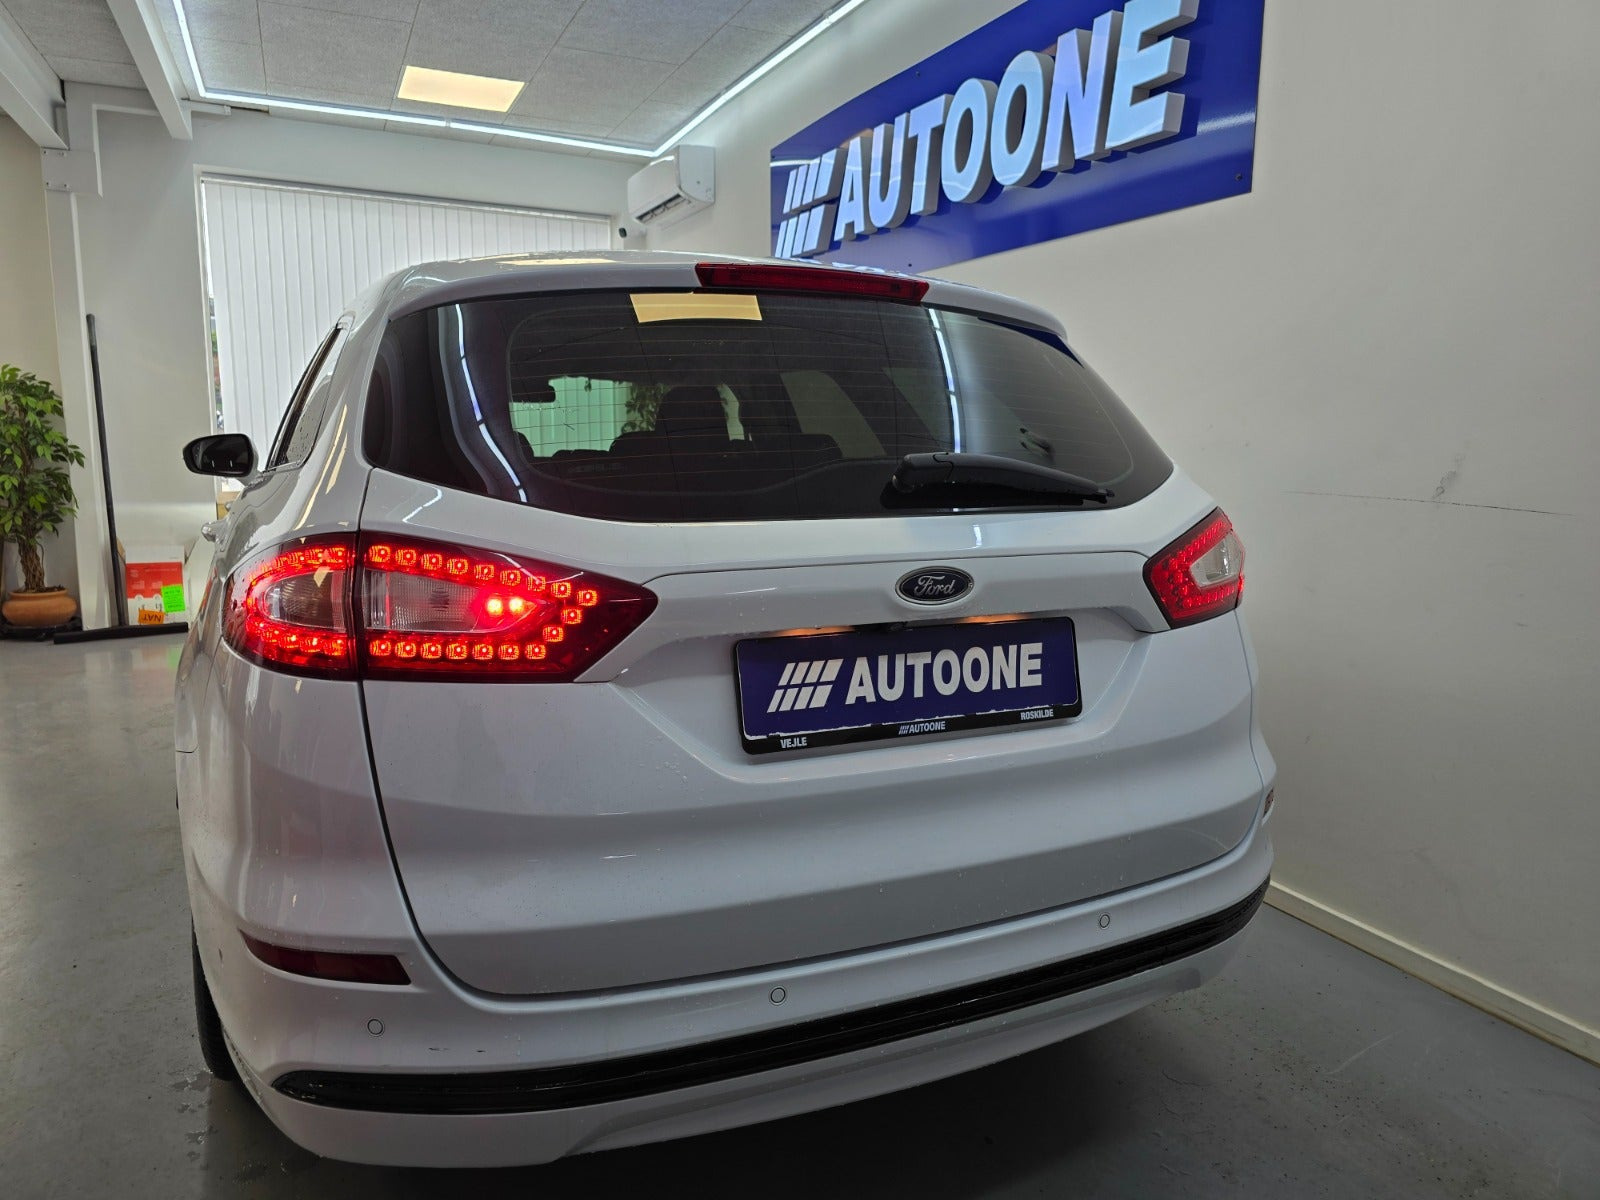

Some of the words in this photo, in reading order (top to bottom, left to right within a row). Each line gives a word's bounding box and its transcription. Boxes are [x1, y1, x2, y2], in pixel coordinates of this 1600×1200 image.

[834, 0, 1199, 243] AUTOONE
[914, 575, 956, 596] Ford
[845, 642, 1043, 705] AUTOONE
[1020, 708, 1054, 721] ROSKILDE
[908, 721, 946, 735] AUTOONE
[780, 736, 808, 749] VEJLE
